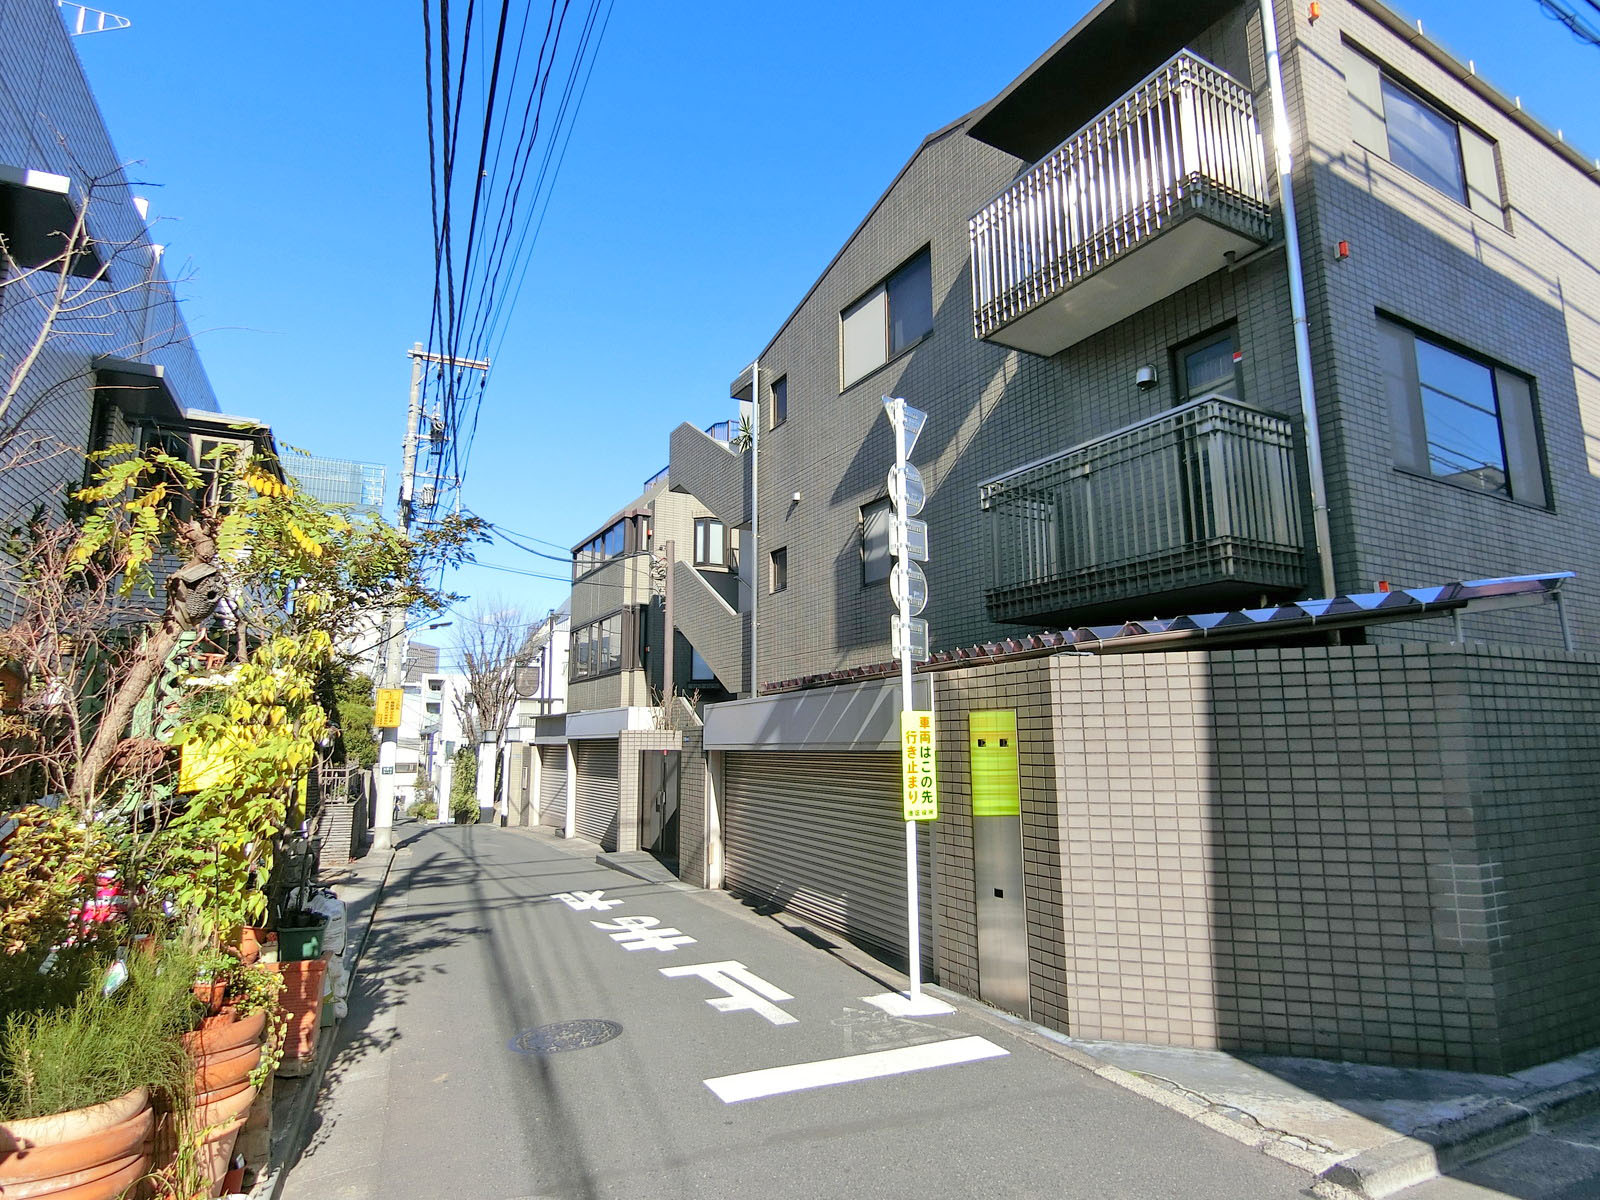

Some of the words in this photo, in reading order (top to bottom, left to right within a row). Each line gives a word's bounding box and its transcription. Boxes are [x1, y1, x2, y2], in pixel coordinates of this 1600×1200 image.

[906, 730, 918, 804] 行き止まり
[919, 716, 933, 804] 車両はこの先
[550, 889, 799, 1025] 止まれ
